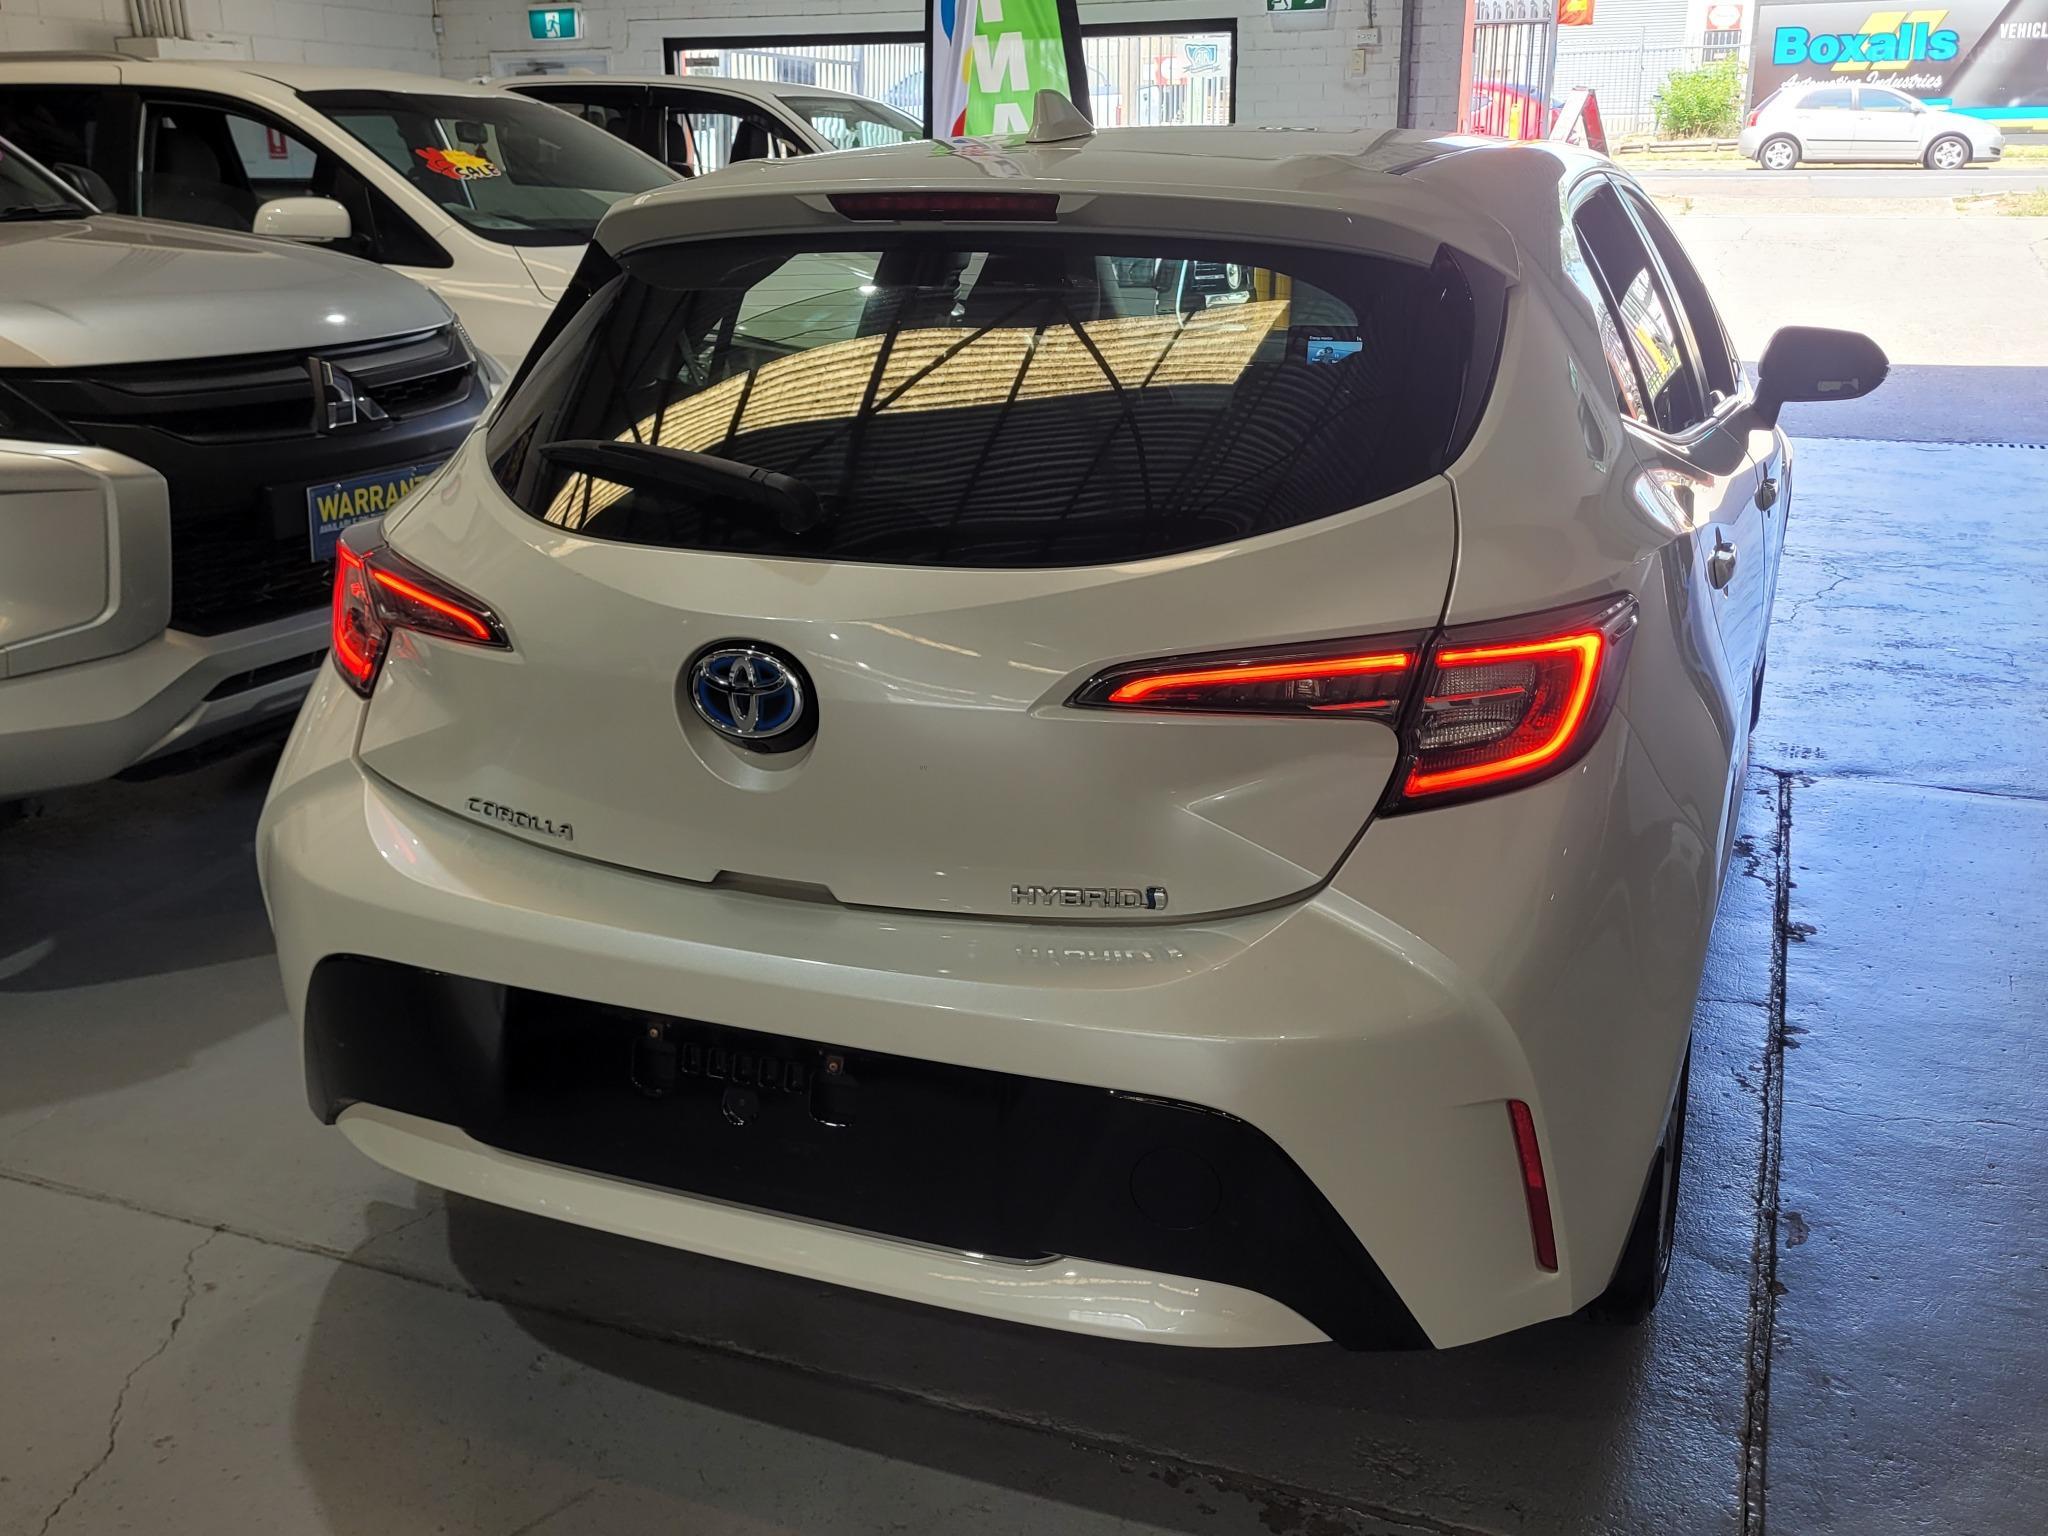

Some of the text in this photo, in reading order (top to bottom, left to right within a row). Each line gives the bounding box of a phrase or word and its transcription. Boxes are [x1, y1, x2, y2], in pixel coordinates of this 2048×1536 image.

[1773, 22, 1959, 65] Boxalls
[1866, 70, 1943, 90] Industries
[455, 163, 500, 180] SALE
[467, 797, 574, 841] COROLLA
[1010, 885, 1143, 909] HYBRID
